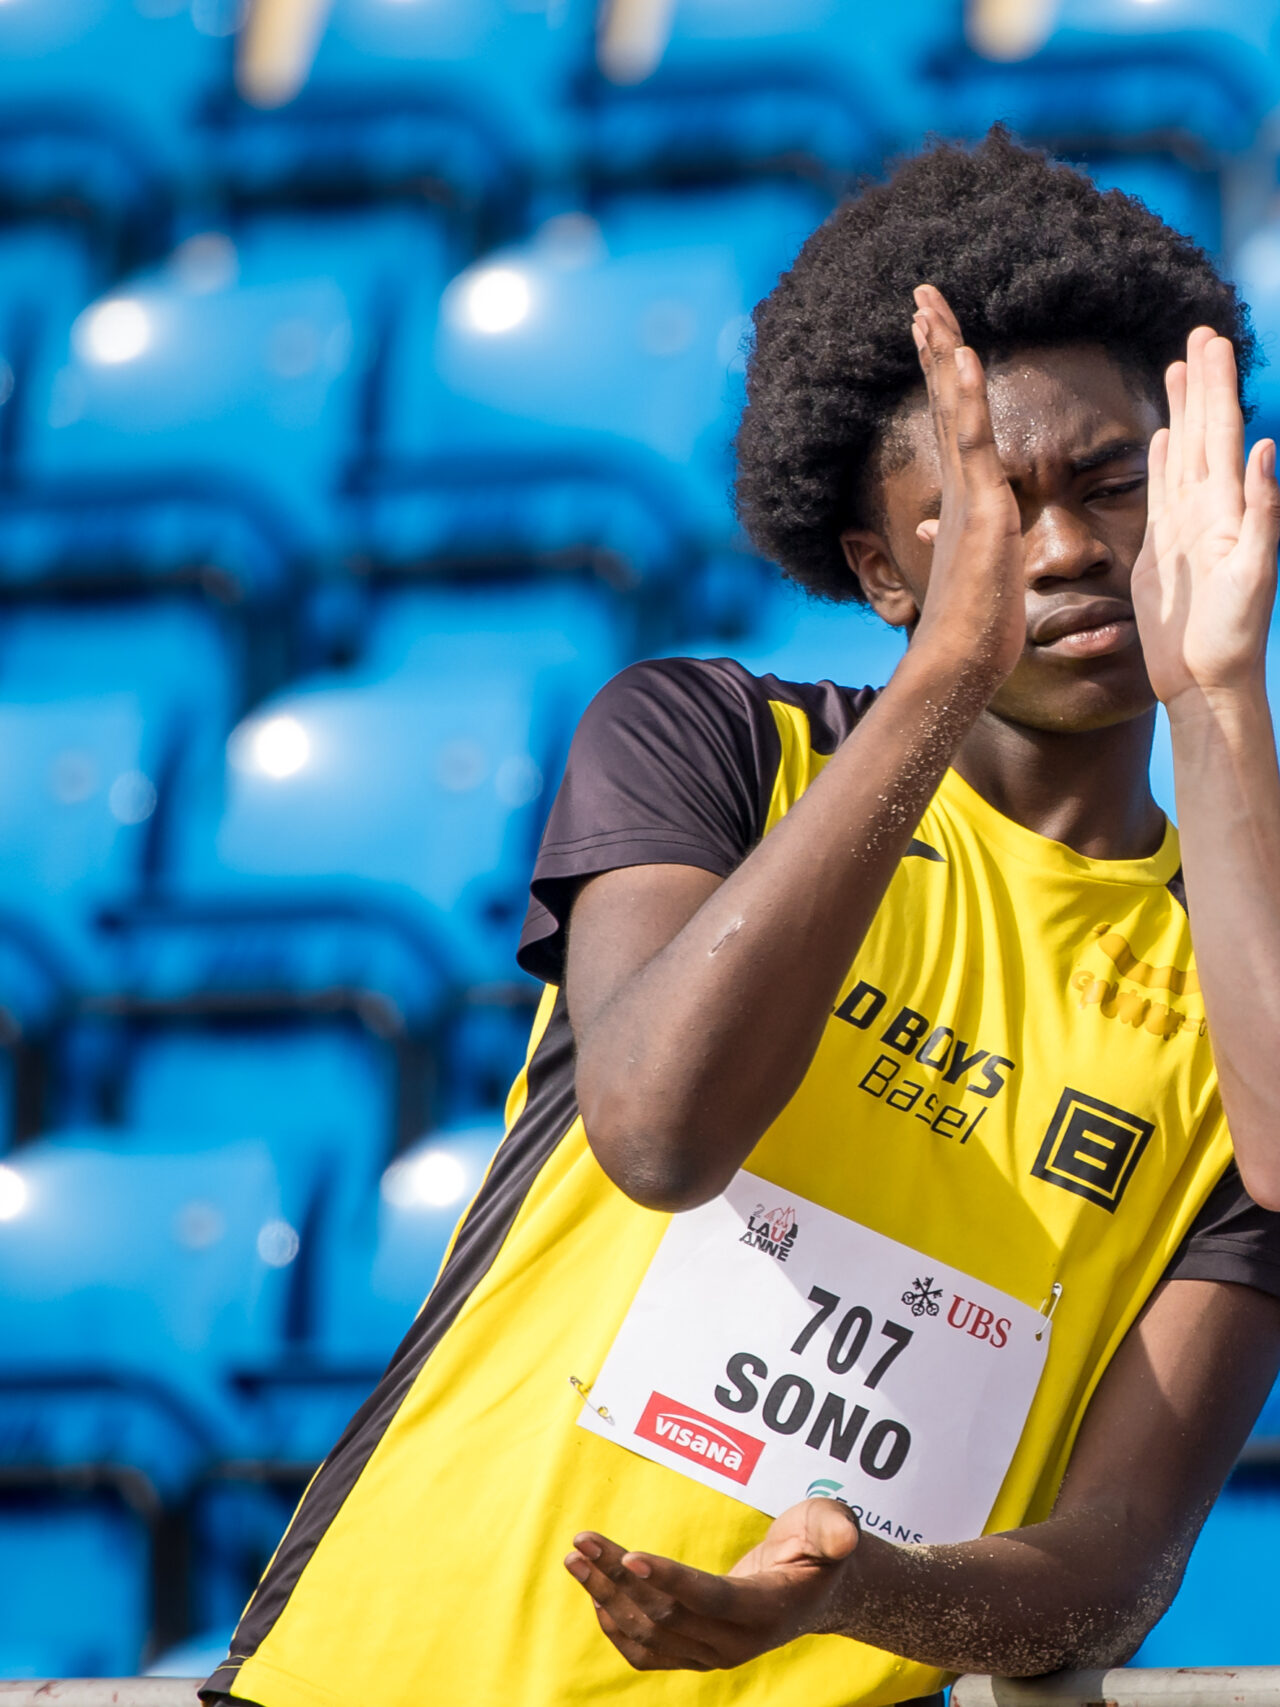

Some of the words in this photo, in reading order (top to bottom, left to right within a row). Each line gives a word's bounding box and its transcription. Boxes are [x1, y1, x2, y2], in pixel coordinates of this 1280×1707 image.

[880, 1005, 1016, 1099] BOYS
[857, 1053, 988, 1145] Basel
[738, 1231, 791, 1262] ANNE
[789, 1284, 915, 1391] 707
[945, 1294, 1013, 1350] UBS
[713, 1351, 913, 1482] SONO
